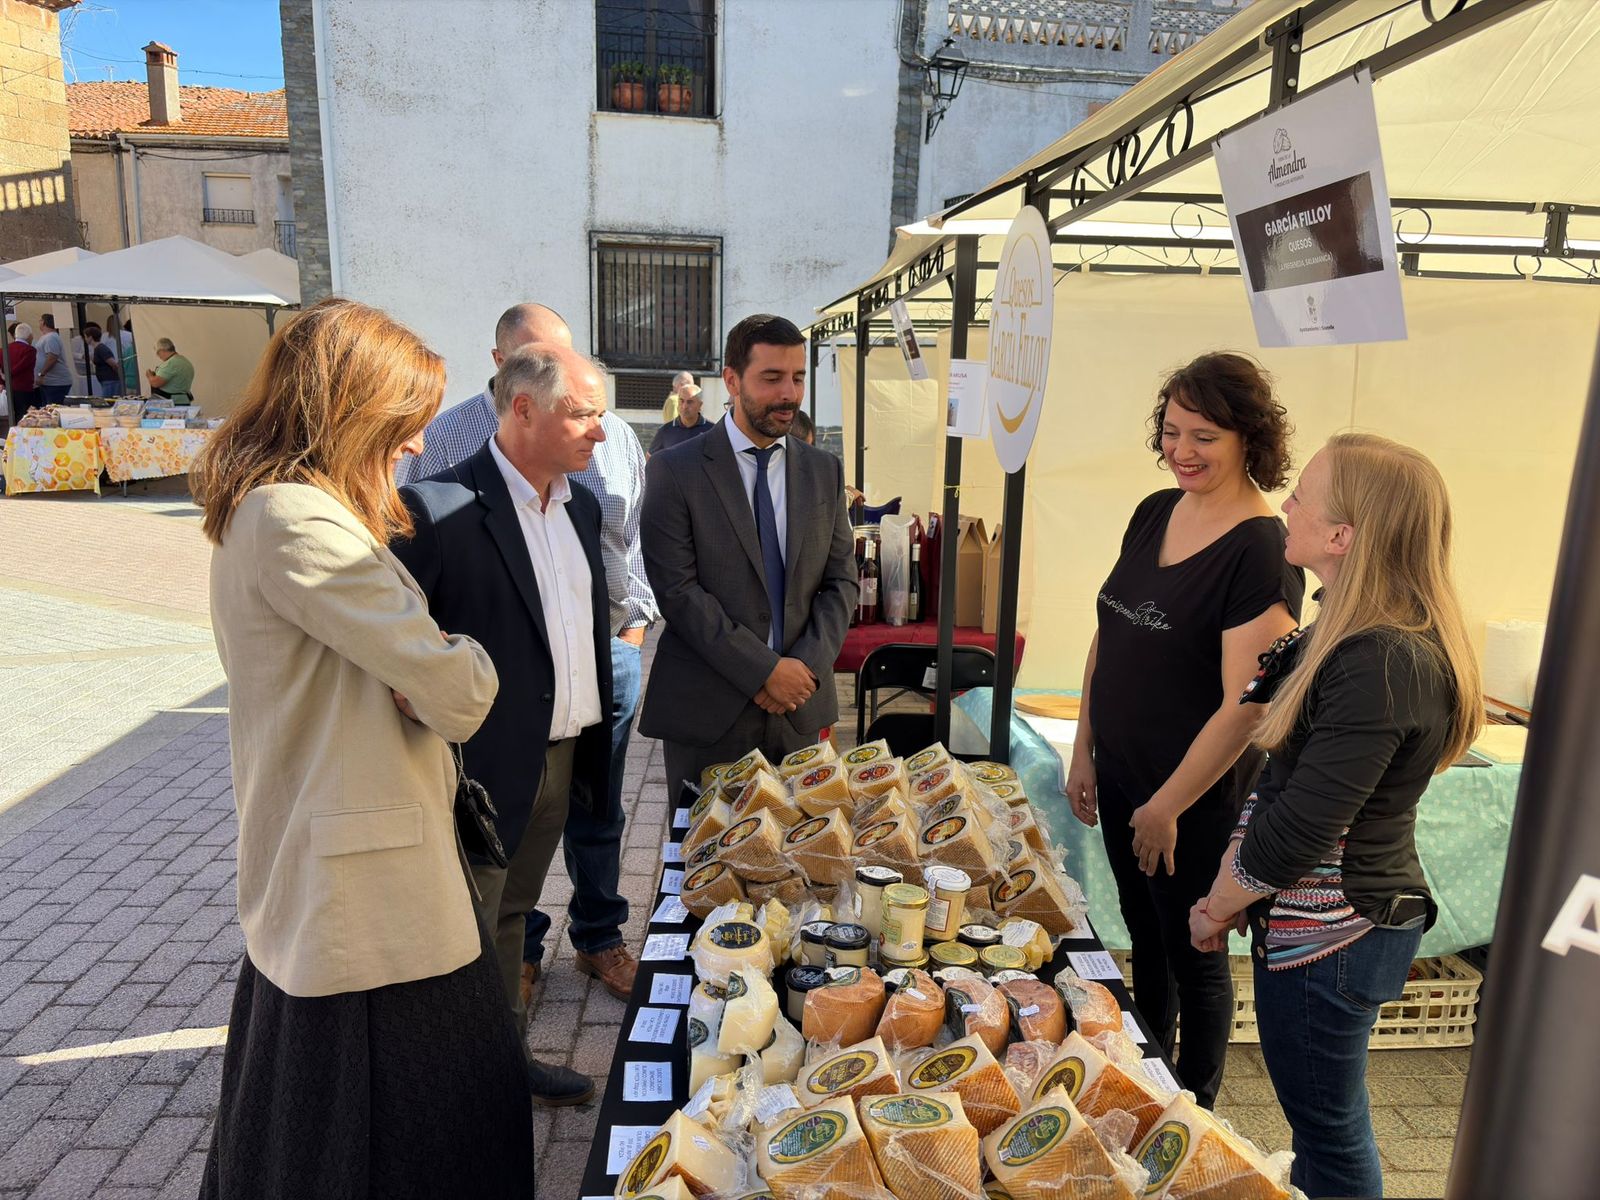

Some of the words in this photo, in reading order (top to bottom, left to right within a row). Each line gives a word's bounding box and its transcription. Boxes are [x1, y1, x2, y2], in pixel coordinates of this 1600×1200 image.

[1267, 149, 1307, 184] Almendra
[1265, 210, 1299, 237] GARCÍA
[1299, 203, 1332, 228] FILLOY
[1288, 237, 1313, 253] QUESOS
